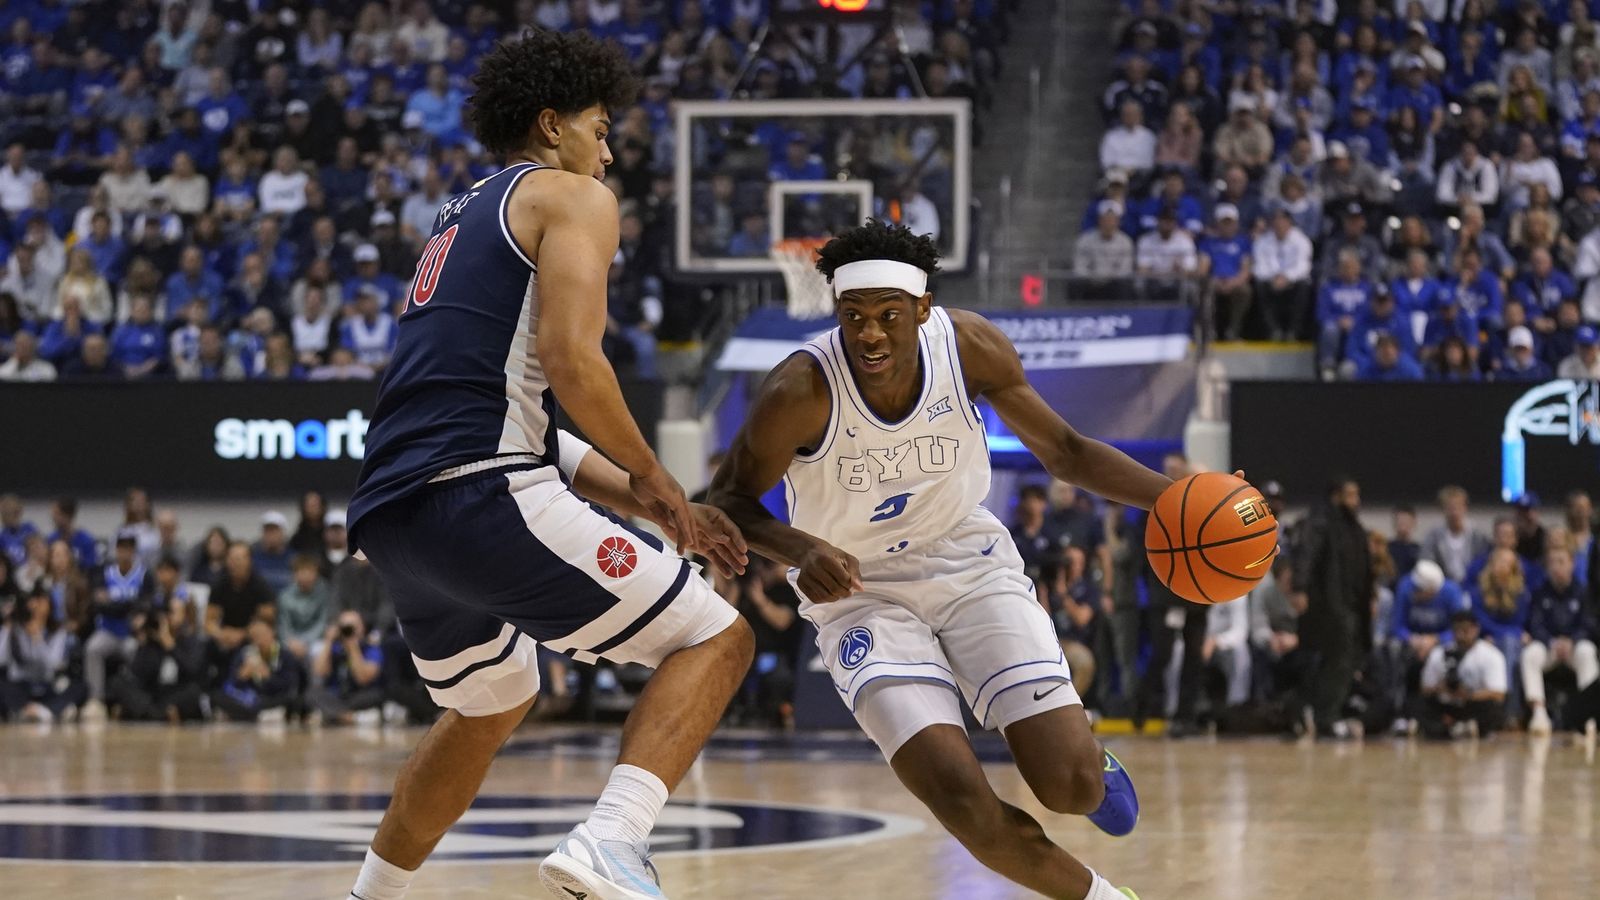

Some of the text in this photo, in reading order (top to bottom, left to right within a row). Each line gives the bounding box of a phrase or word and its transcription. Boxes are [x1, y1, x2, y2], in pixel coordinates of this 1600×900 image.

[214, 408, 371, 460] smart
[838, 435, 959, 492] BYU
[1236, 499, 1272, 527] ELIT
